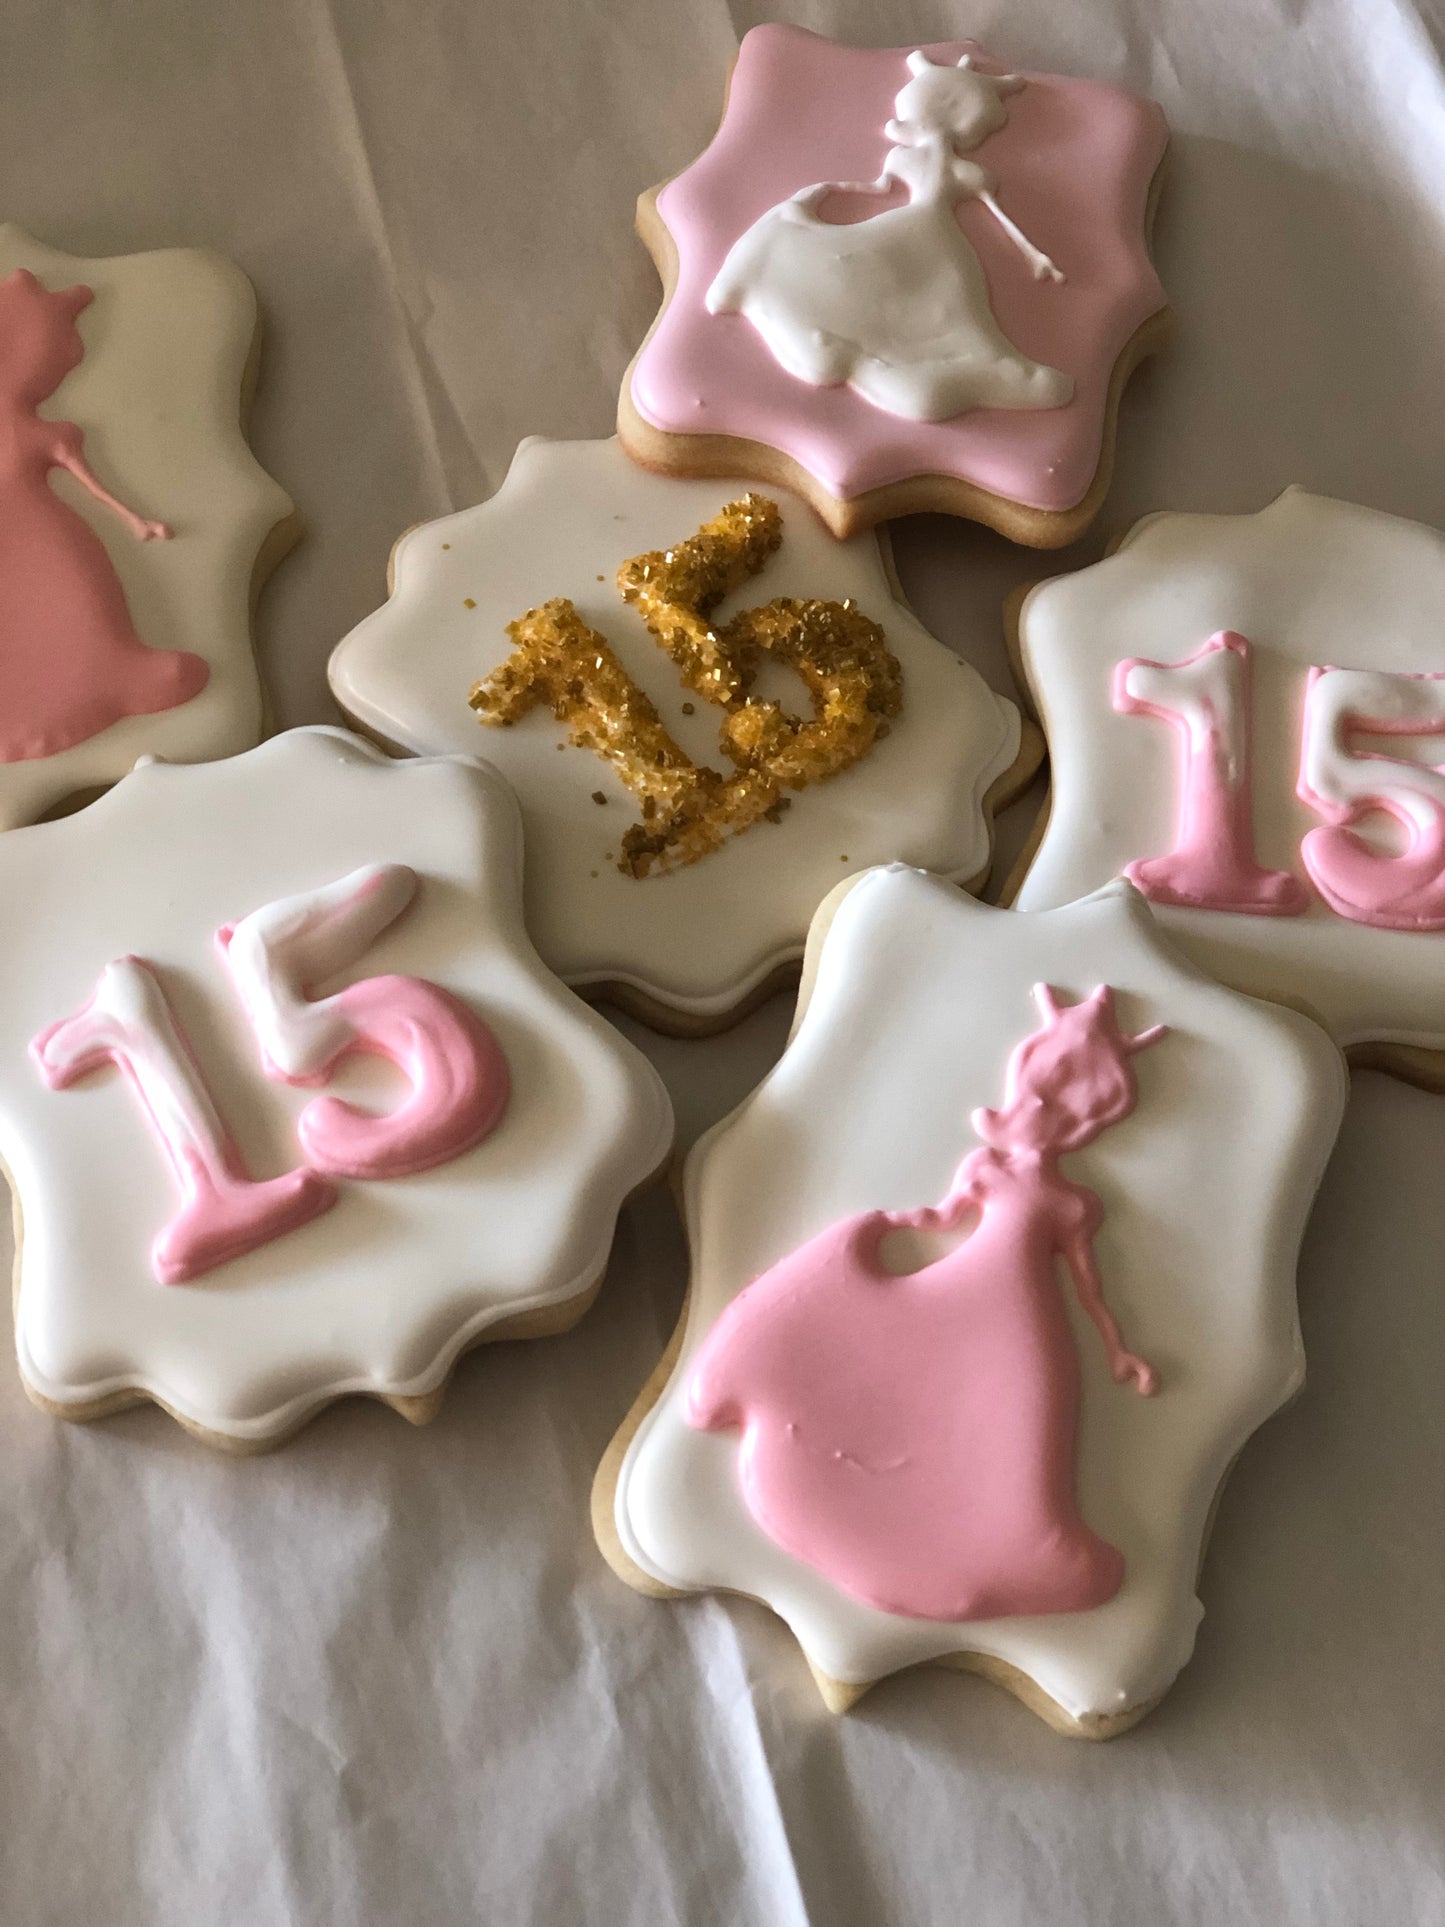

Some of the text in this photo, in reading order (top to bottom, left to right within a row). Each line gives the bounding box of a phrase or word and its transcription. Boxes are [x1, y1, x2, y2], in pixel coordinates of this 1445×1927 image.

[469, 493, 903, 879] 15
[1113, 630, 1445, 931] 15
[28, 863, 511, 1286] 15
